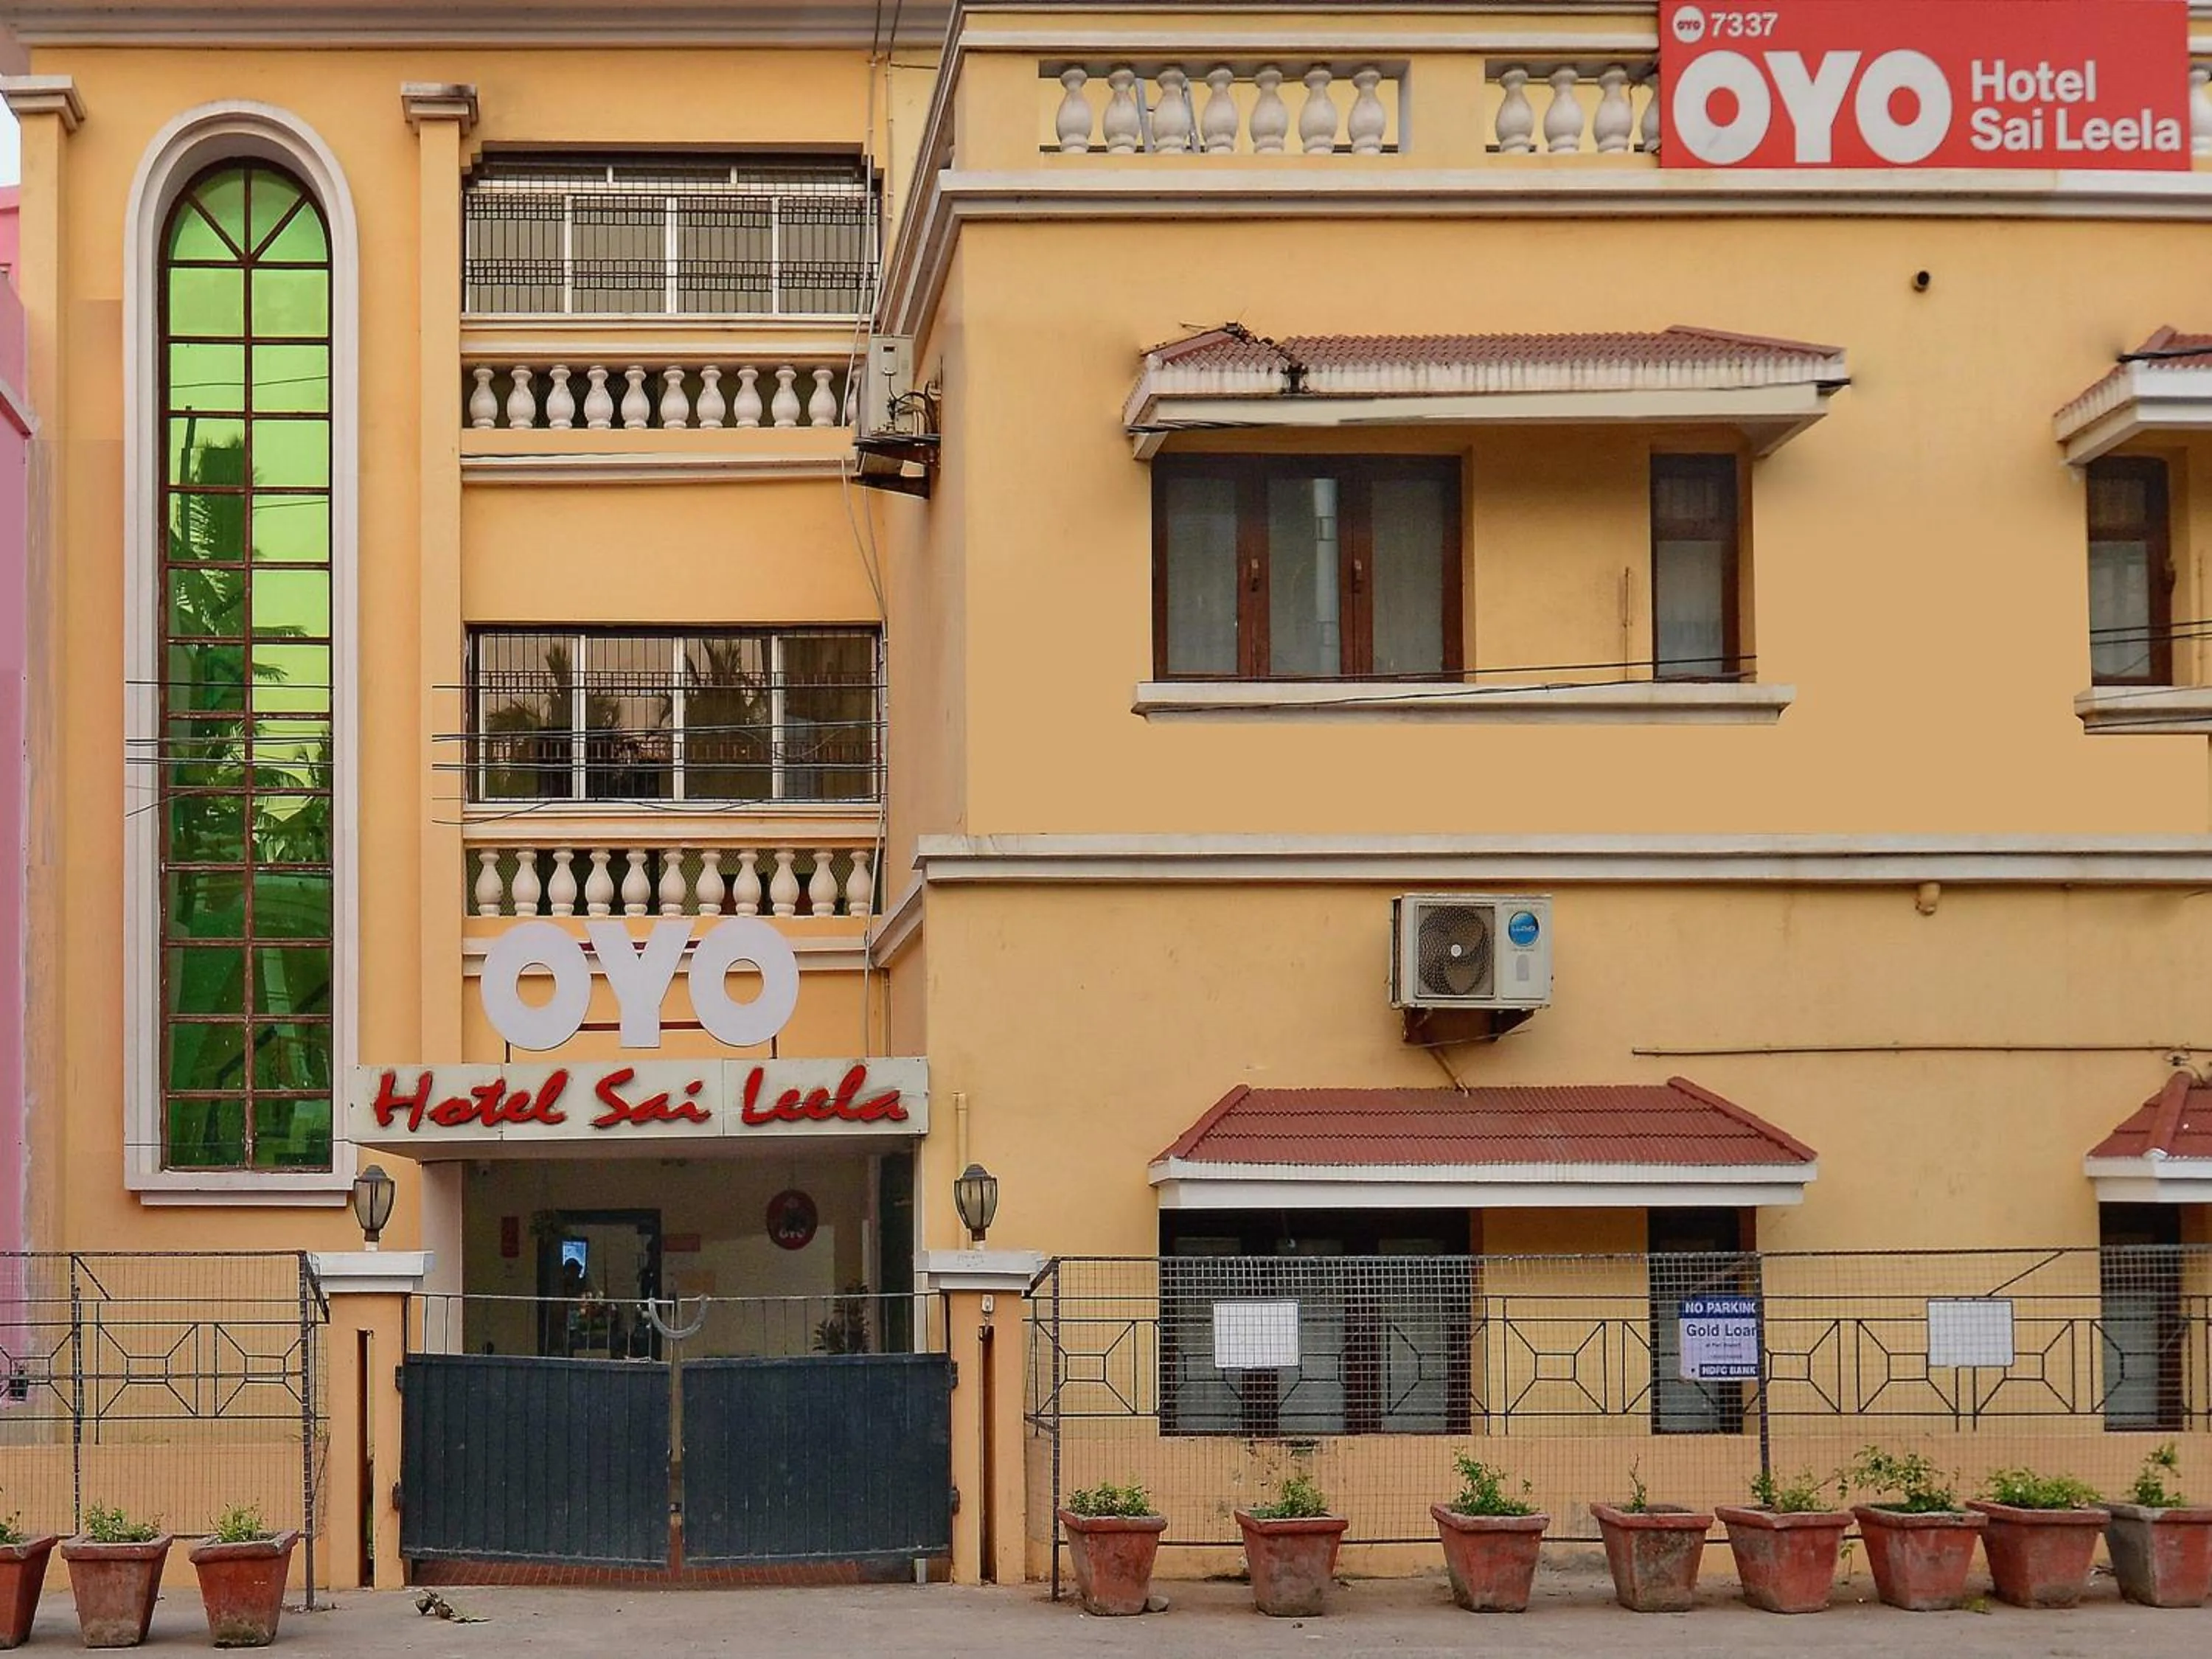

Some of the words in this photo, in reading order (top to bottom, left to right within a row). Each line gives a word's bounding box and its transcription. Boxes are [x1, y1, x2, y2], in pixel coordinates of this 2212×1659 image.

[1677, 21, 1700, 30] OYO
[1711, 12, 1778, 37] 7337
[1970, 59, 2096, 102] Hotel
[1672, 49, 1952, 164] OYO
[1969, 108, 2043, 150] Sai
[2056, 108, 2181, 150] Leela
[481, 917, 800, 1051] OYO
[370, 1067, 568, 1132] Hotel
[589, 1067, 712, 1129] Sai
[742, 1065, 909, 1124] Leela
[1685, 1301, 1703, 1313] NO
[1686, 1324, 1719, 1337] Gold
